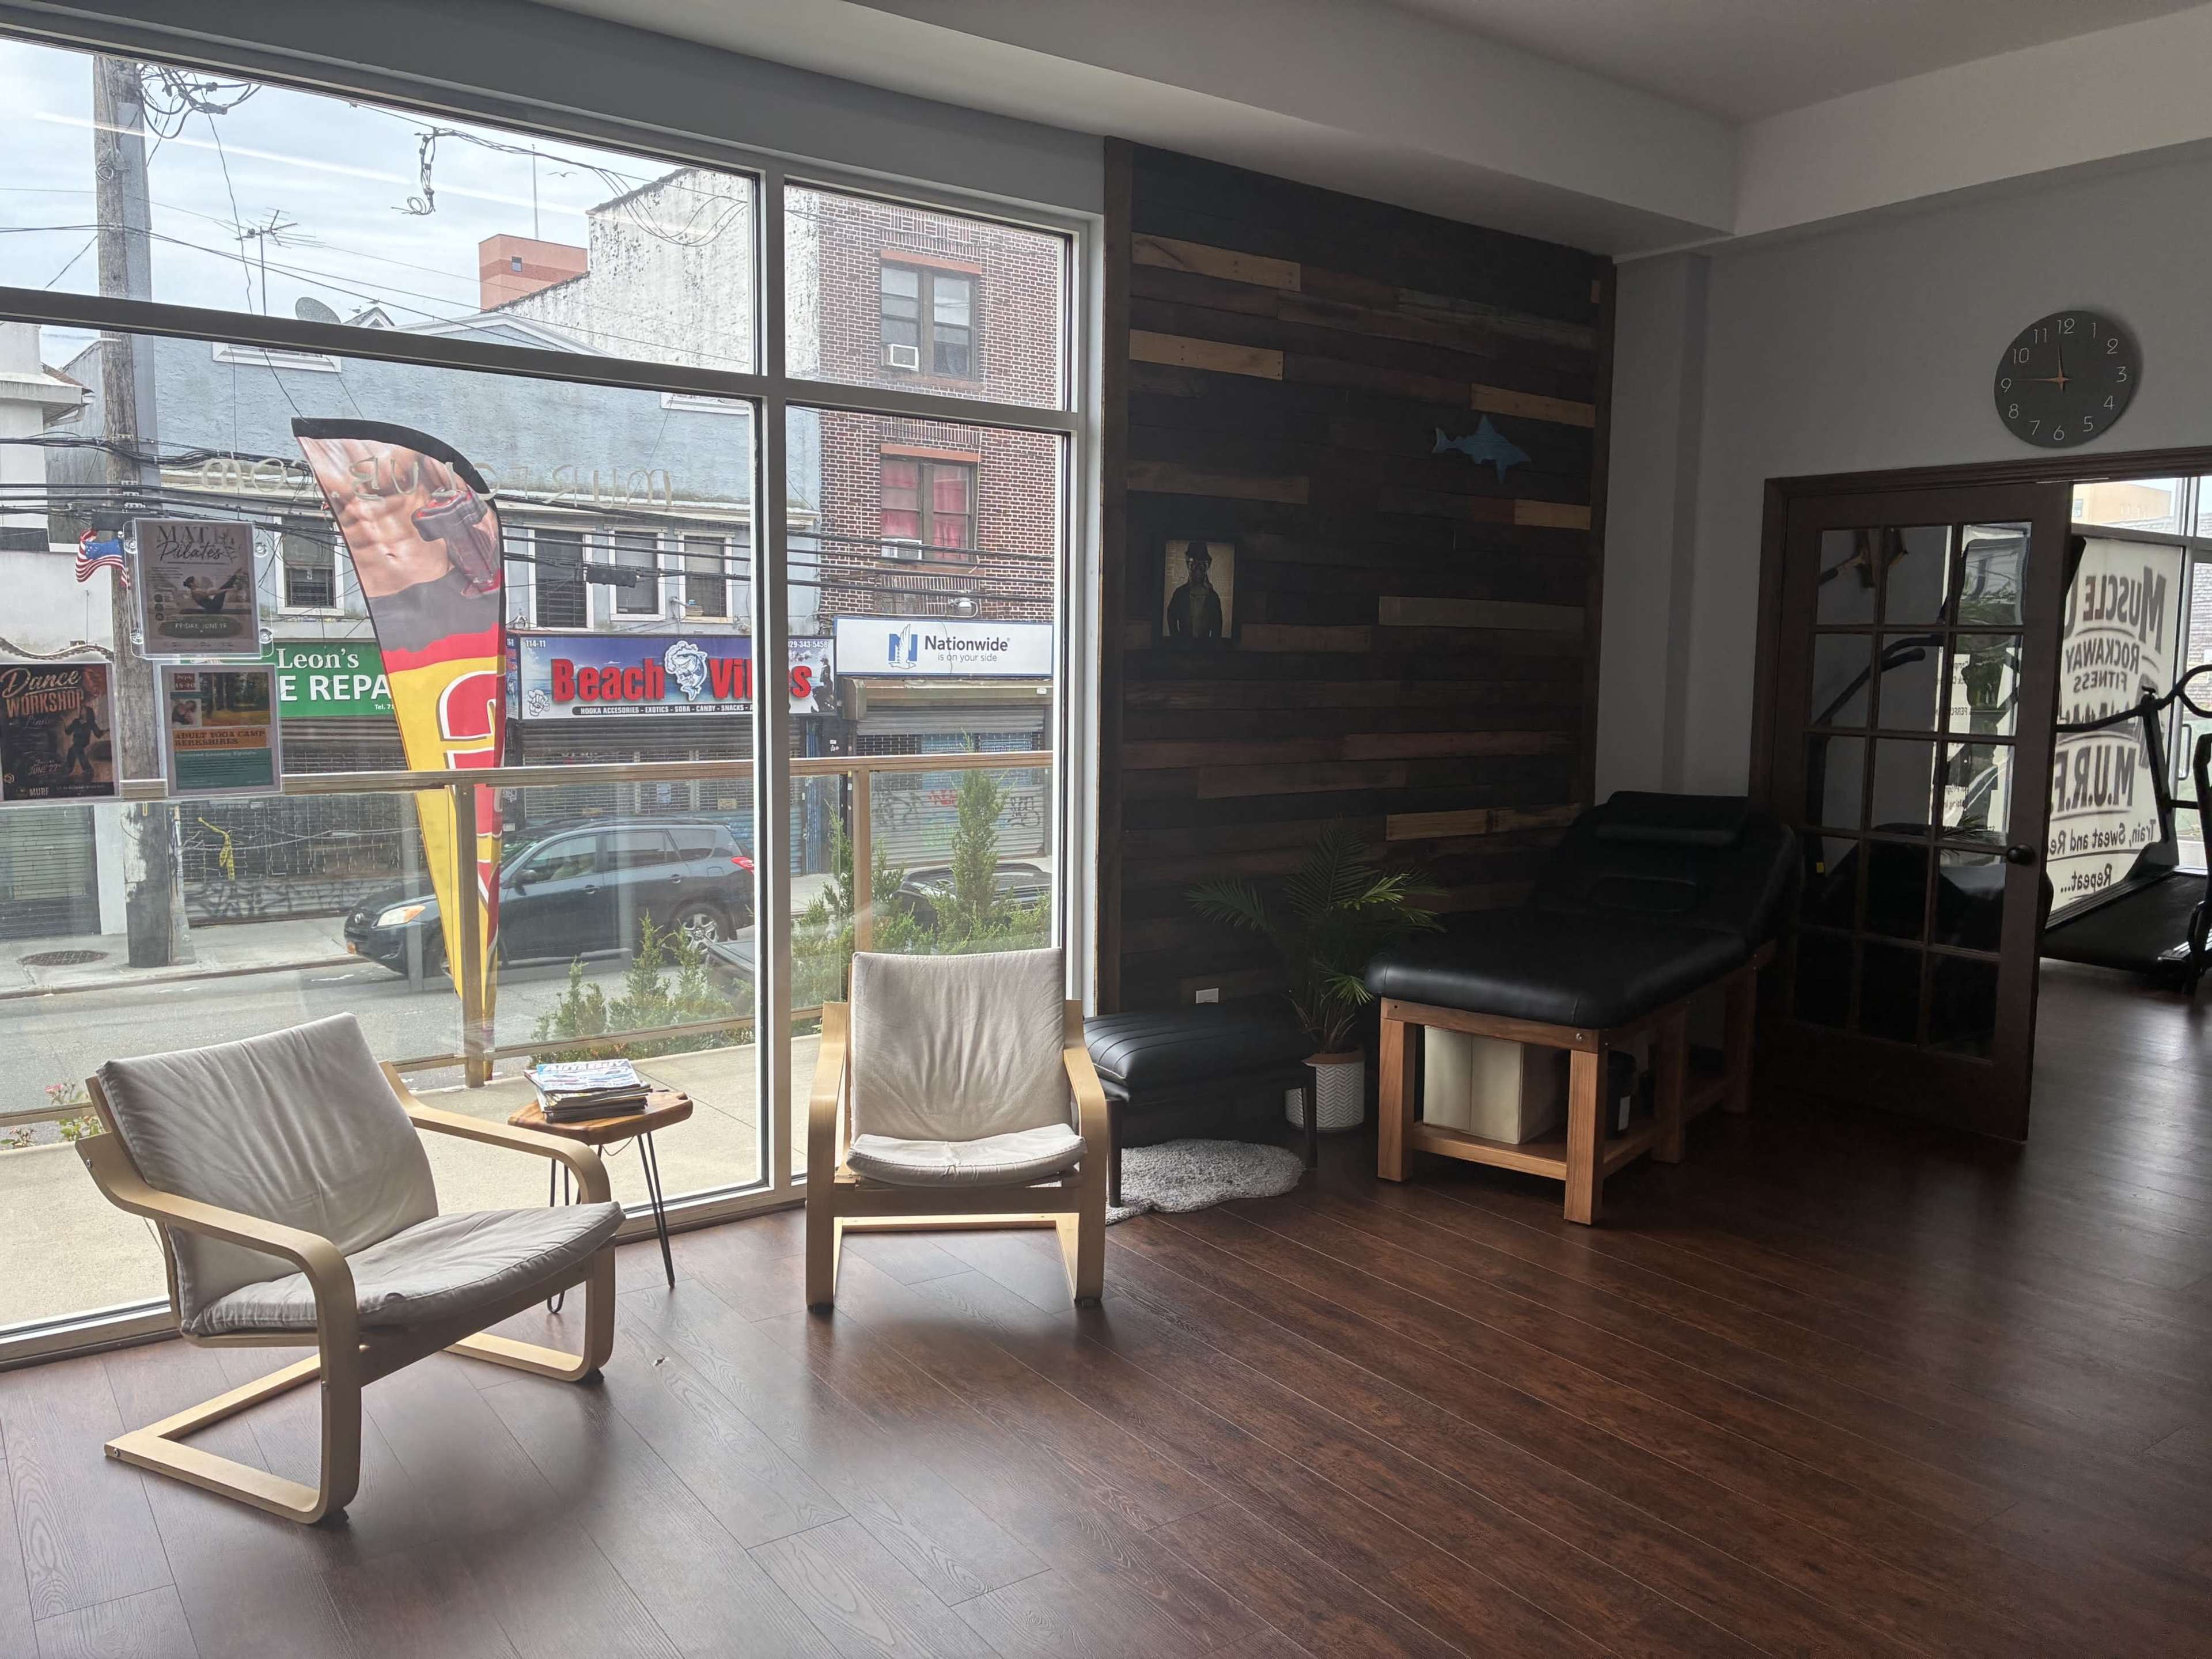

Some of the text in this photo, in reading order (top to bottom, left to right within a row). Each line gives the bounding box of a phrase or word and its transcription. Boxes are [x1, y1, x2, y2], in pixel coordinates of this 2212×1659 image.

[2057, 318, 2075, 334] 12
[2092, 322, 2096, 339] 1
[2034, 328, 2047, 344] 11
[2107, 338, 2119, 354] 2
[2013, 347, 2029, 364] 10
[2116, 366, 2127, 382] 3
[2001, 378, 2012, 393] 9
[2009, 403, 2019, 418] 8
[2103, 396, 2115, 410] 4
[2028, 420, 2040, 435] 7
[2083, 416, 2093, 432] 5
[2053, 425, 2065, 440] 6
[157, 540, 224, 562] Pilates
[525, 640, 546, 648] 114-11
[925, 635, 1008, 652] Nationwide
[276, 648, 359, 669] Leon's
[938, 653, 944, 661] is
[960, 654, 978, 662] your
[980, 653, 997, 662] side
[0, 668, 82, 698] Dance
[551, 658, 666, 703] Beach
[6, 688, 84, 718] WORKSHOP
[603, 706, 639, 714] ACCESORIES
[238, 730, 266, 738] CAMP
